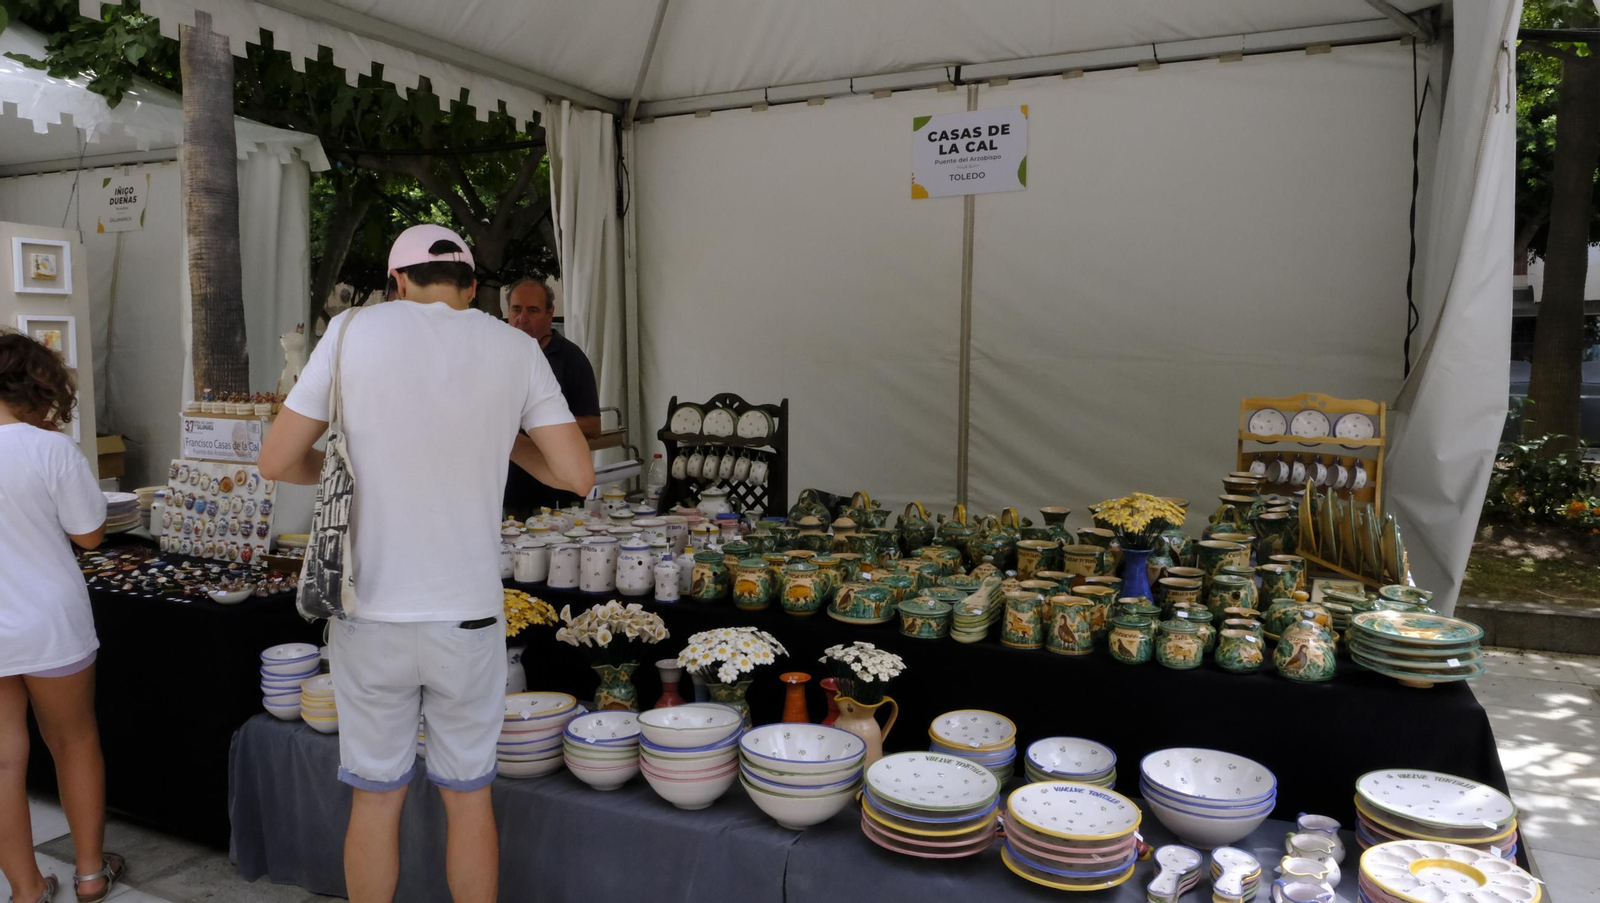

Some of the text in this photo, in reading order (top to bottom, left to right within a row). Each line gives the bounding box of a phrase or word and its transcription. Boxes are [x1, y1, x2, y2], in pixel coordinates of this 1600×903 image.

[927, 124, 1010, 143] CASAS DE
[939, 140, 998, 155] LA CAL
[934, 157, 957, 166] Puente
[969, 154, 1002, 163] Arzobispo
[949, 171, 986, 181] TOLEDO
[109, 194, 138, 205] DUEÑAS
[184, 420, 195, 432] 37
[185, 437, 260, 452] Francisco Casas de la Cal
[925, 755, 954, 765] VUELVE
[1053, 786, 1085, 794] VUELVE
